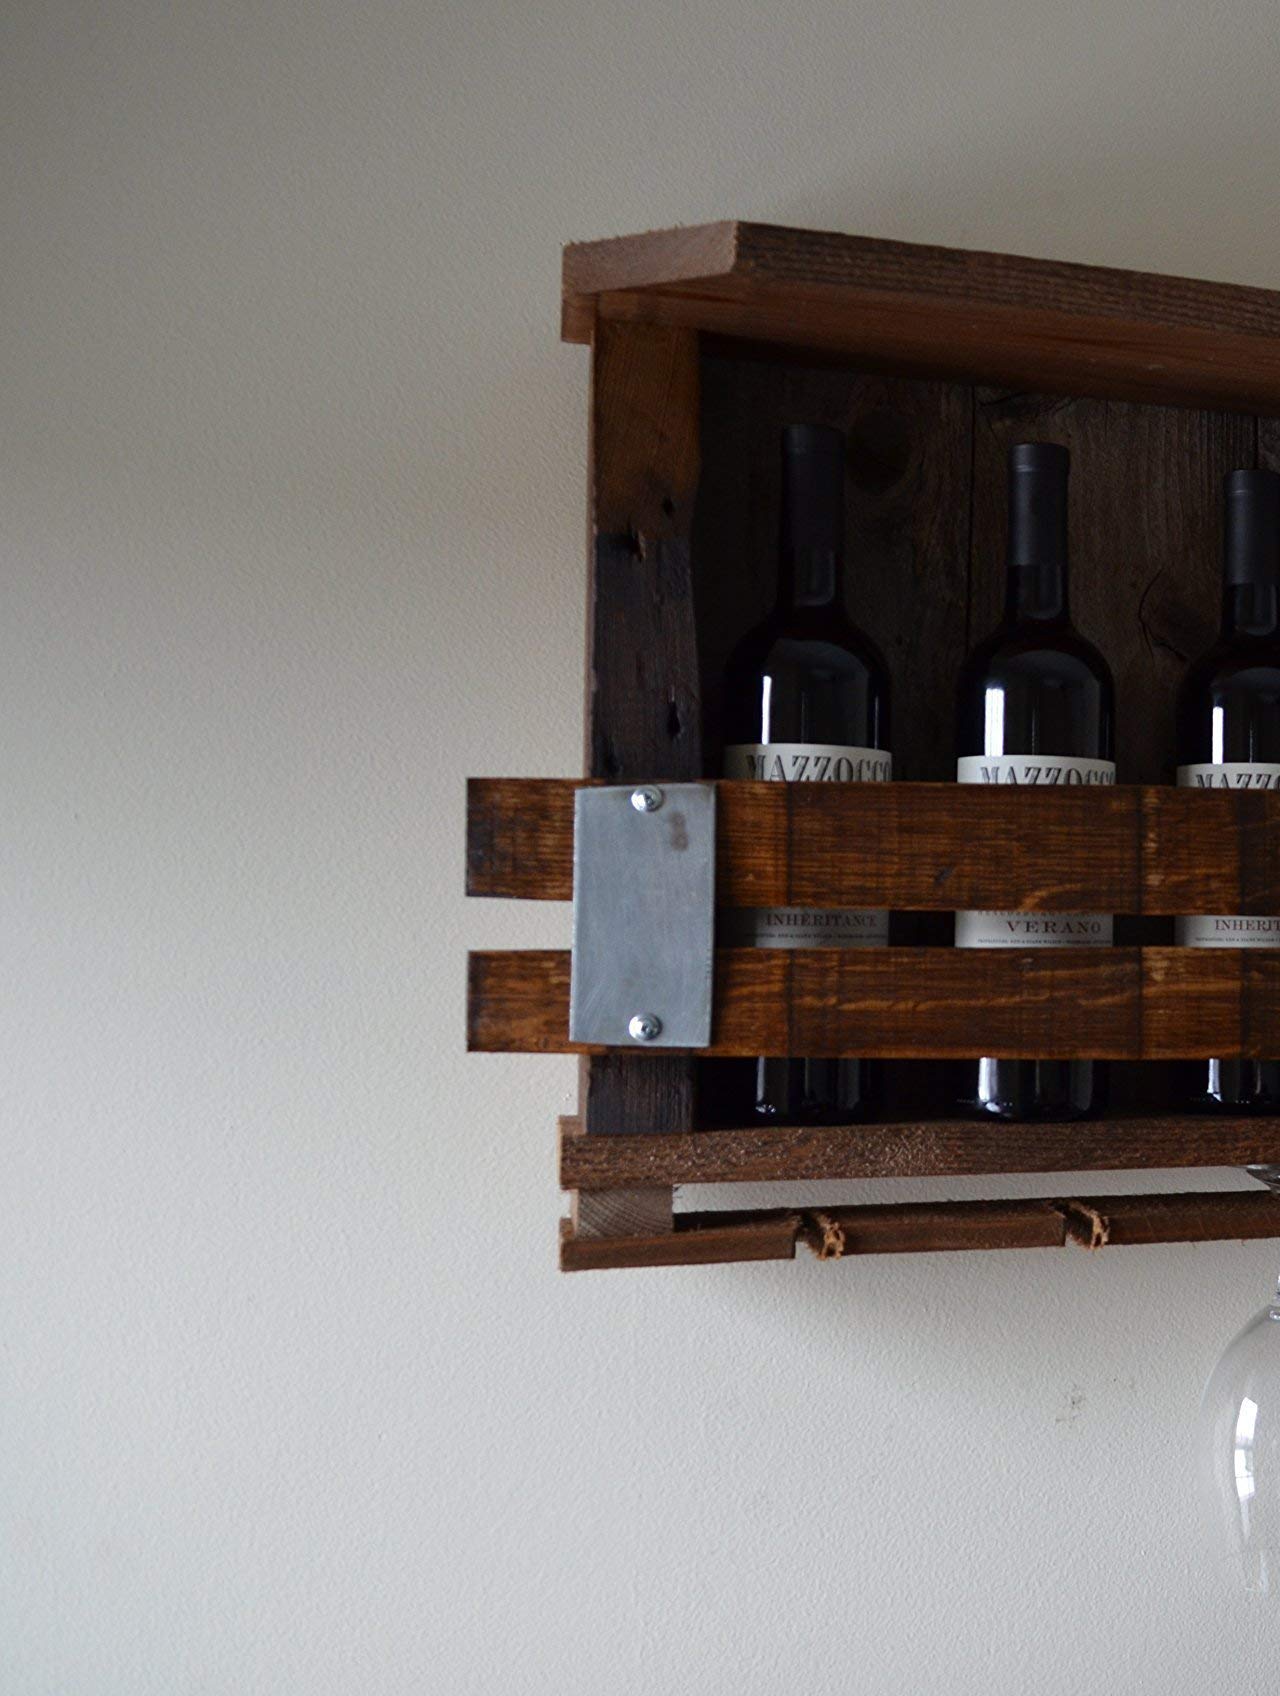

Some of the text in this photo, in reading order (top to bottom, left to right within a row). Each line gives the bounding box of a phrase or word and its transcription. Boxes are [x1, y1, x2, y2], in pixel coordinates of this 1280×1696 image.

[746, 754, 892, 782] MAZZOCCO
[766, 913, 877, 927] INHERITANCE
[1006, 919, 1102, 934] VERANO
